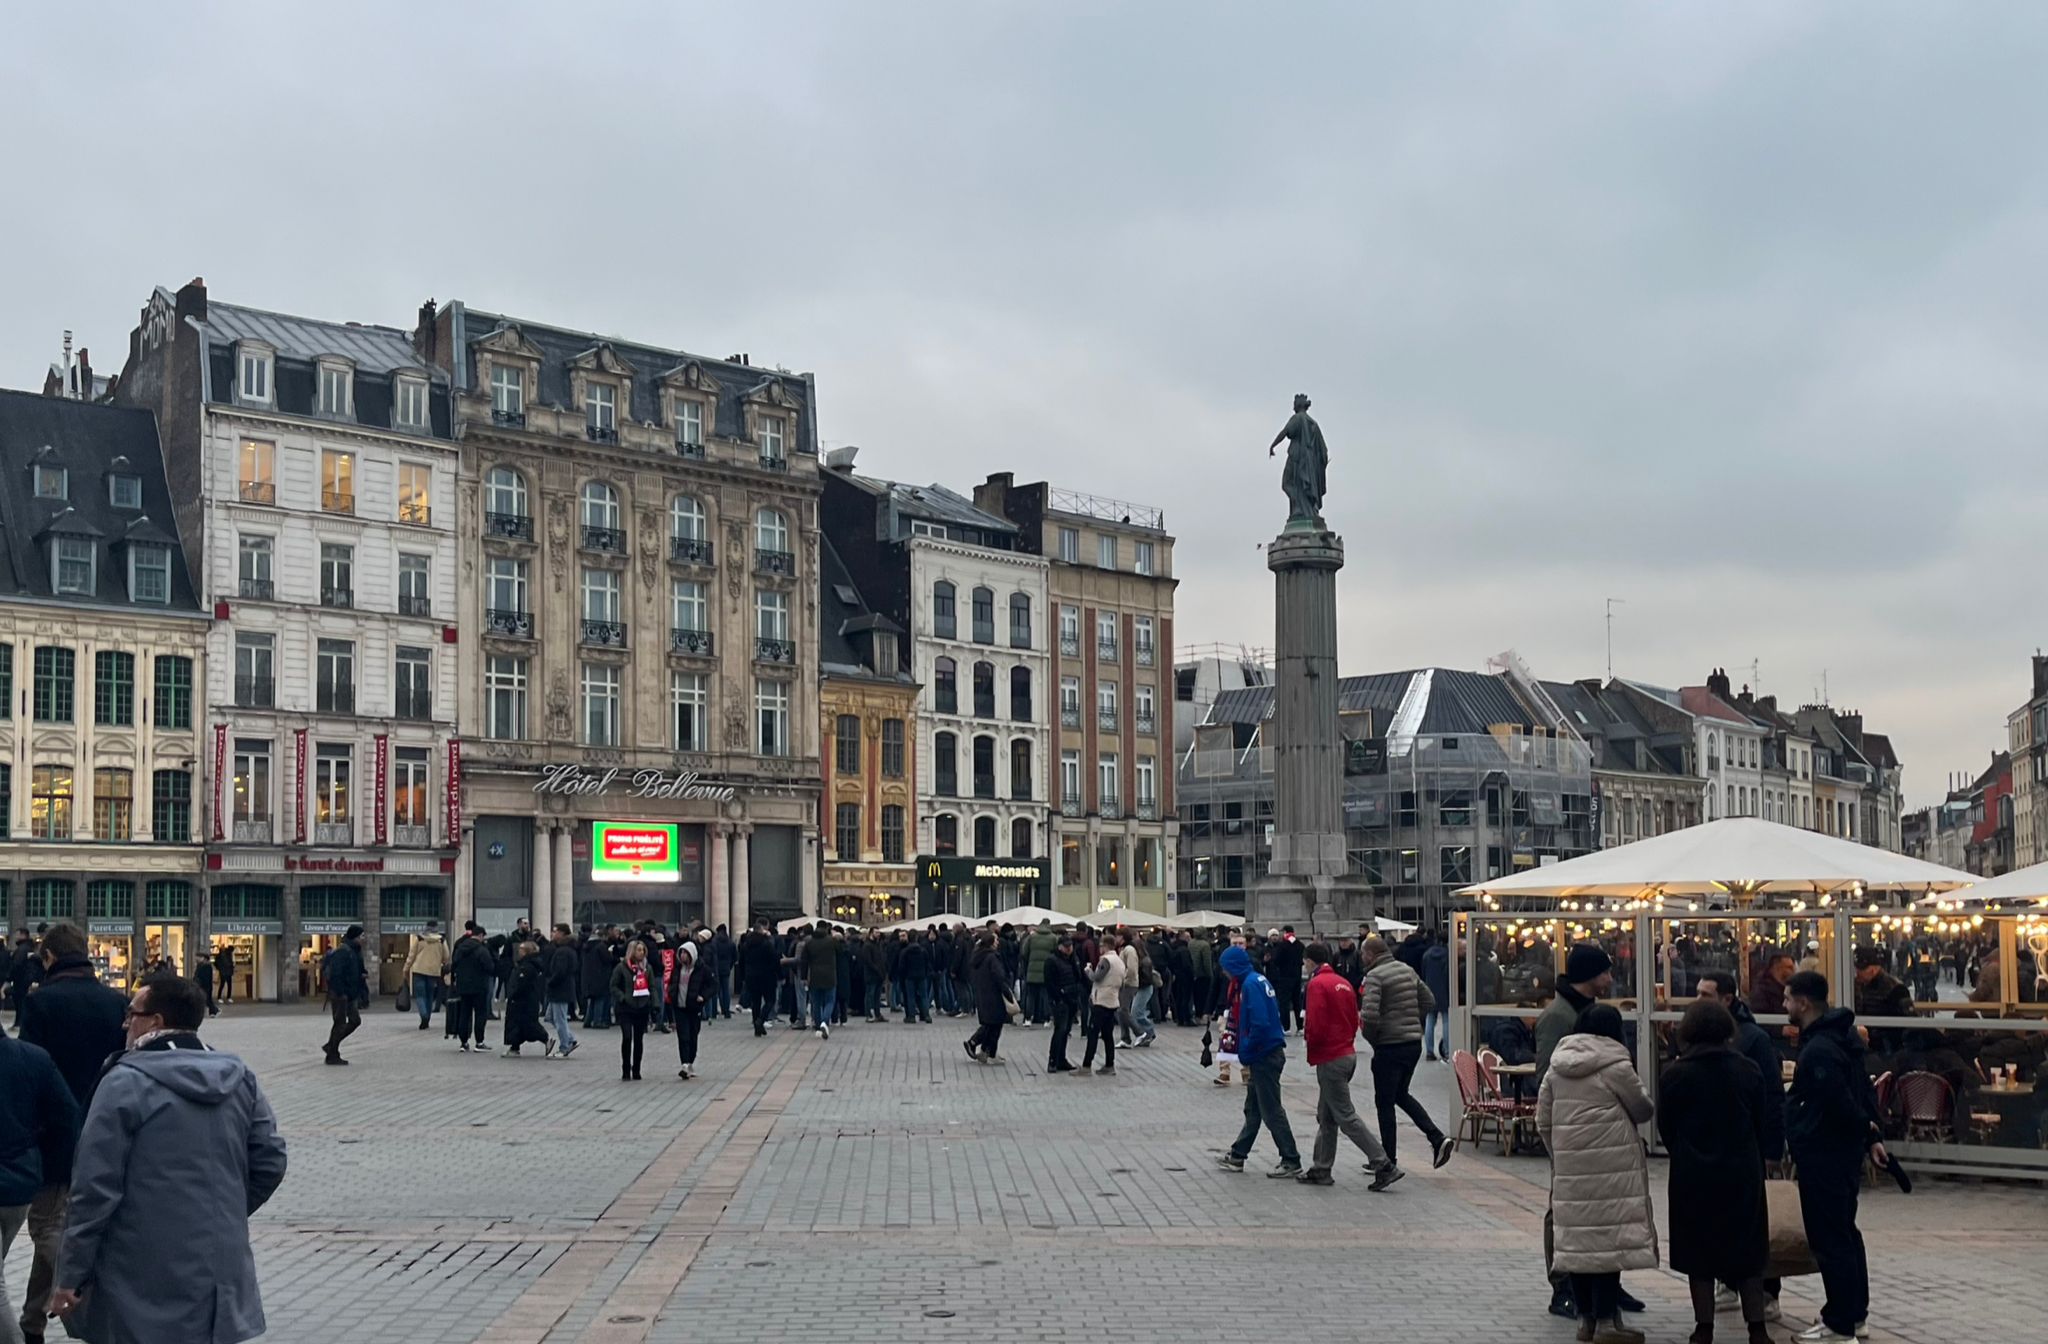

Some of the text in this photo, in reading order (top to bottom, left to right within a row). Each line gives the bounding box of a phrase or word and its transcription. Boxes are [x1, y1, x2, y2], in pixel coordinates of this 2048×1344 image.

[297, 734, 305, 770] nord
[377, 777, 384, 798] du
[450, 743, 458, 842] Furet du nord
[532, 764, 735, 801] Hôtel Bellevue
[377, 799, 385, 840] Furet
[284, 855, 384, 871] le furet du nord
[974, 864, 1040, 878] McDonald's
[227, 923, 267, 932] Librairie
